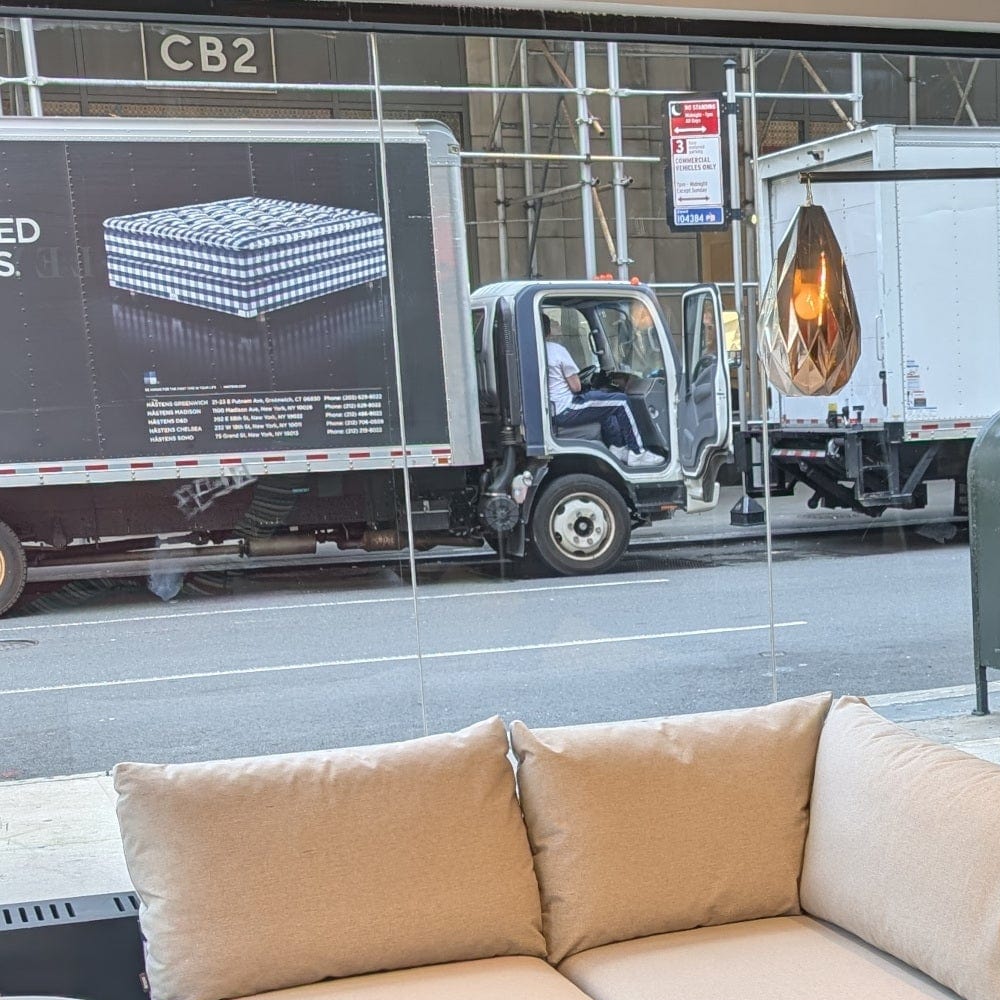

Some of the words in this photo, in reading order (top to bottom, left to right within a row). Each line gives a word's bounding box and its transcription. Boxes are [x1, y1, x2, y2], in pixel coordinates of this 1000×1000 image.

[160, 34, 258, 74] CB2
[676, 140, 684, 154] 3
[677, 214, 704, 224] 104384
[0, 218, 40, 243] ED
